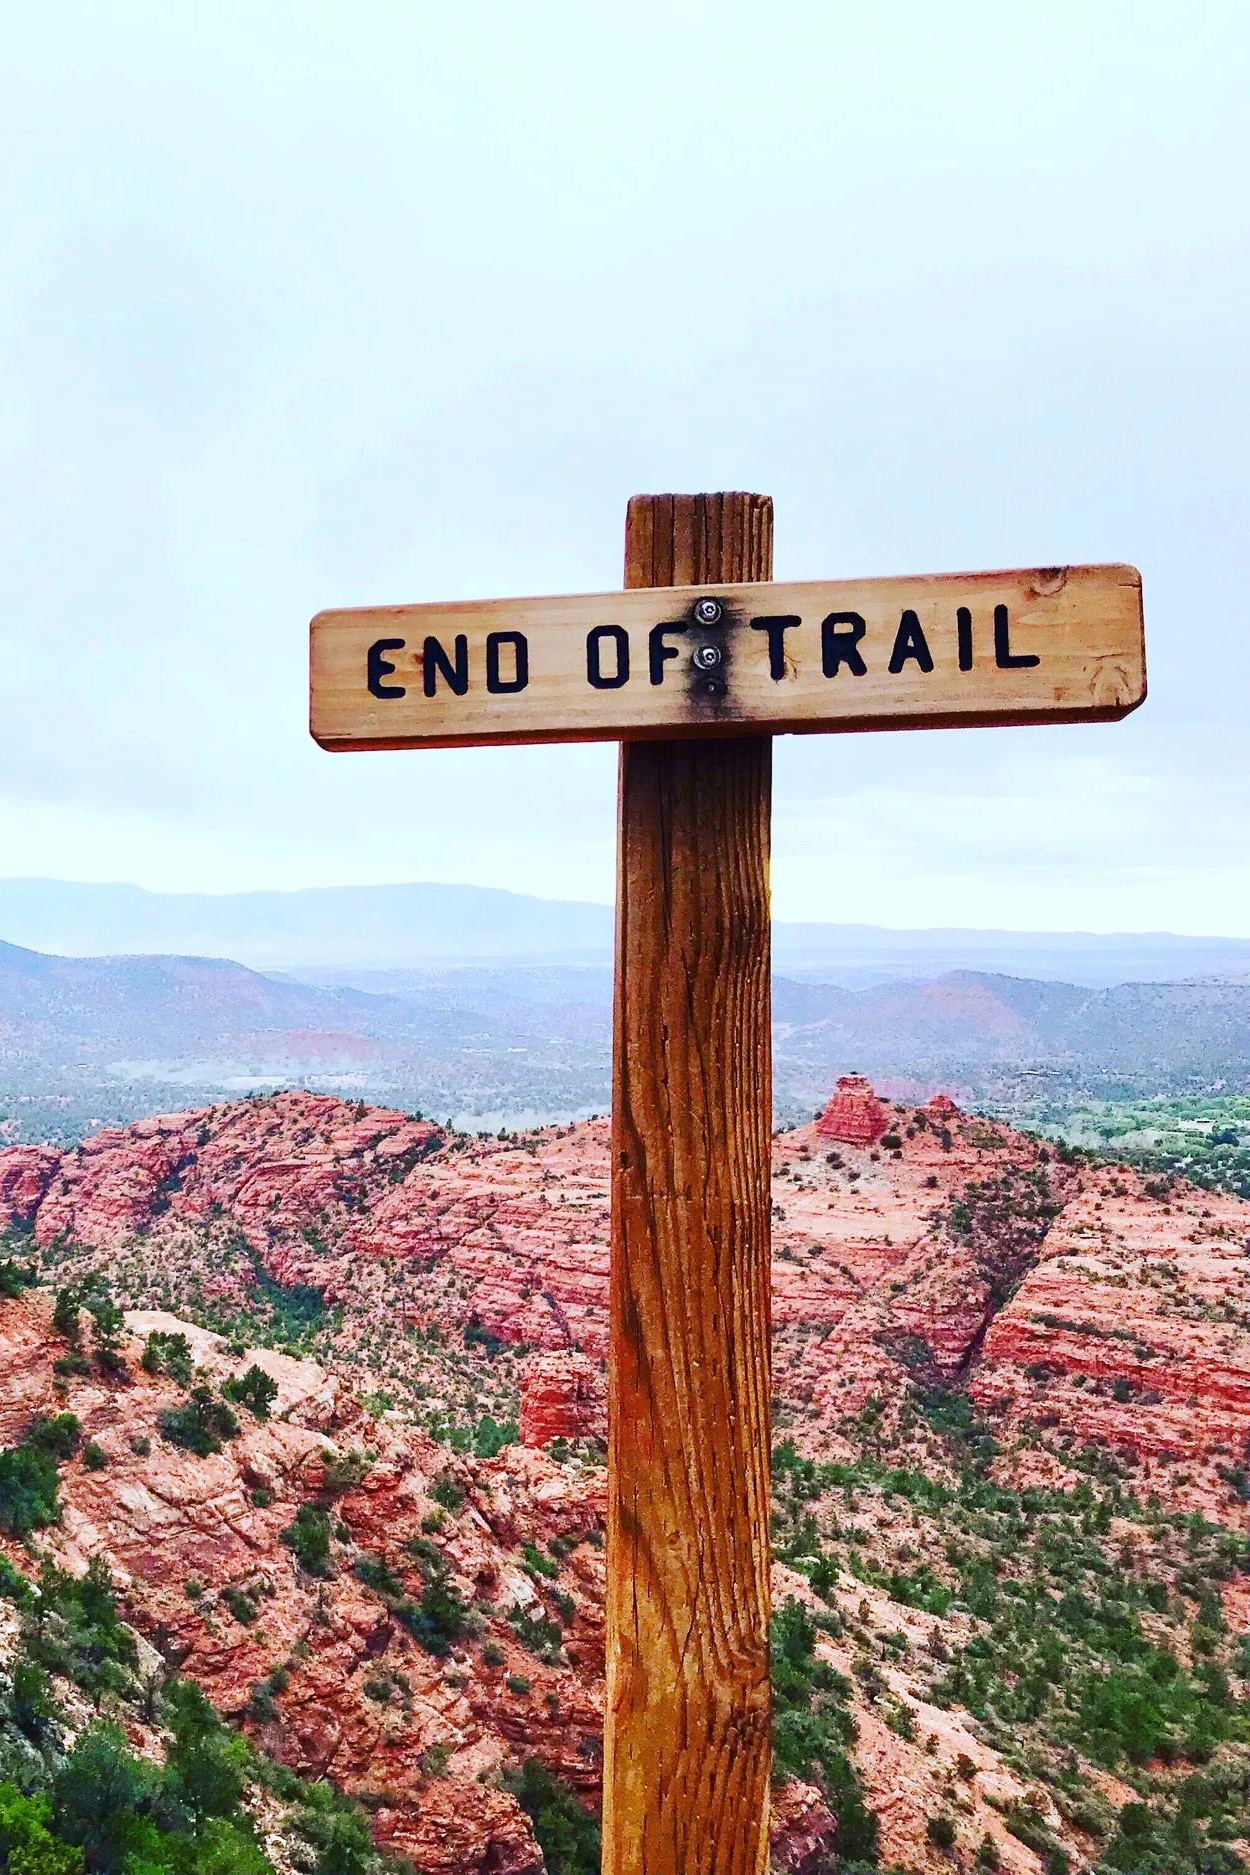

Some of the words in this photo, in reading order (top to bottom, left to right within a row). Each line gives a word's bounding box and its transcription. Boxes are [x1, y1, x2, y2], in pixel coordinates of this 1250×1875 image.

[367, 631, 530, 700] END
[586, 621, 690, 690] OF
[750, 603, 1041, 682] TRAIL
